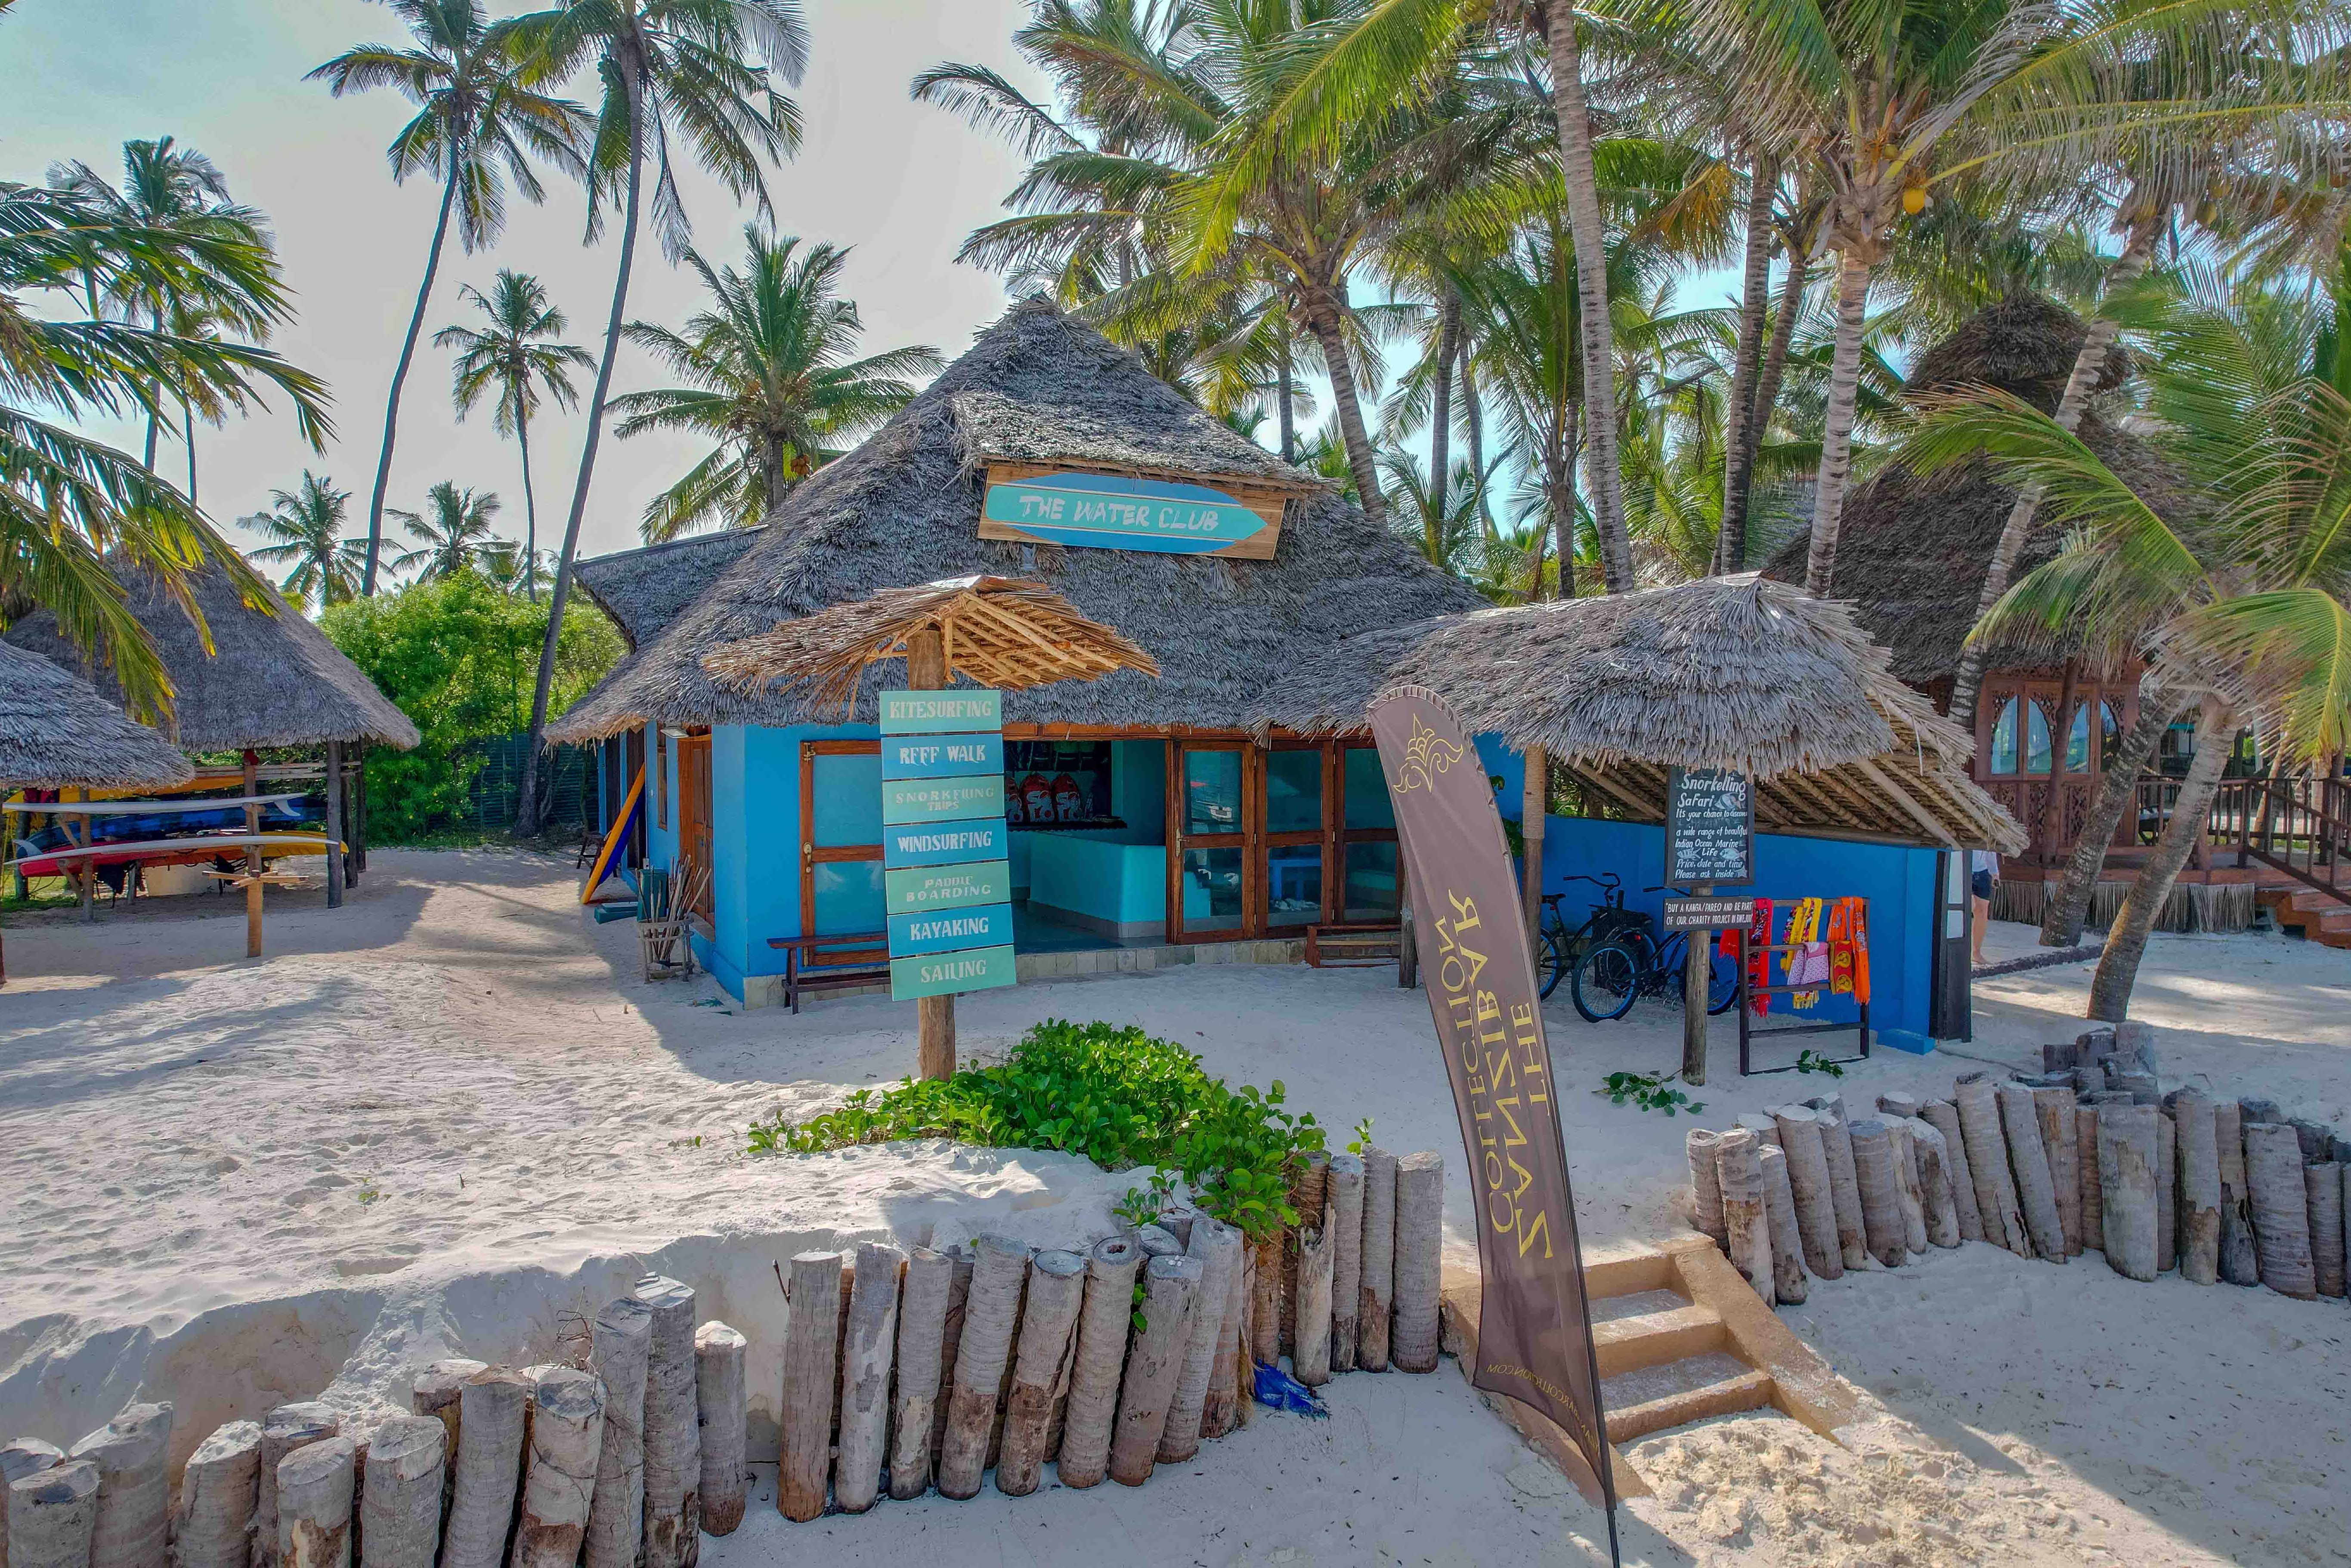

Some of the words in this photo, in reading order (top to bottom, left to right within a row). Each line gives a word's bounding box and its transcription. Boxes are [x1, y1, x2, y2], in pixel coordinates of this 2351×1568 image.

[1019, 495, 1065, 519] THE
[1074, 500, 1151, 526] WATER
[1158, 507, 1219, 531] CLUB
[889, 701, 992, 719] KITESURFING
[899, 746, 939, 766] REEF
[947, 744, 986, 763] WALK
[1682, 773, 1746, 801] Snorkelling
[896, 788, 994, 804] SNORKELLING
[928, 801, 959, 811] TRIPS
[1686, 811, 1701, 821] your
[1703, 808, 1723, 818] chance
[1683, 826, 1695, 836] wide
[1698, 829, 1715, 840] range
[1717, 826, 1723, 836] of
[1724, 825, 1748, 837] beautiful
[897, 831, 992, 853] WINDSURFING
[1675, 838, 1693, 848] Indian
[1695, 839, 1713, 848] Ocean
[1715, 839, 1739, 848] Marine
[1697, 858, 1712, 867] date
[1714, 860, 1726, 868] and
[1729, 859, 1743, 868] time
[1675, 869, 1696, 879] Please
[1700, 870, 1711, 878] ask
[1715, 869, 1734, 878] inside
[925, 876, 973, 889] PADDLE
[906, 884, 991, 902] BOARDING
[1680, 903, 1684, 912] A
[1723, 902, 1733, 911] AND
[1734, 902, 1741, 911] BE
[1742, 901, 1753, 911] PART
[1666, 916, 1674, 926] OF
[1677, 916, 1686, 925] OUR
[1688, 915, 1711, 925] CHARITY
[1712, 914, 1730, 924] PROJECT
[1731, 914, 1736, 923] IN
[909, 917, 989, 941] KAYAKING
[920, 959, 987, 983] SAILING
